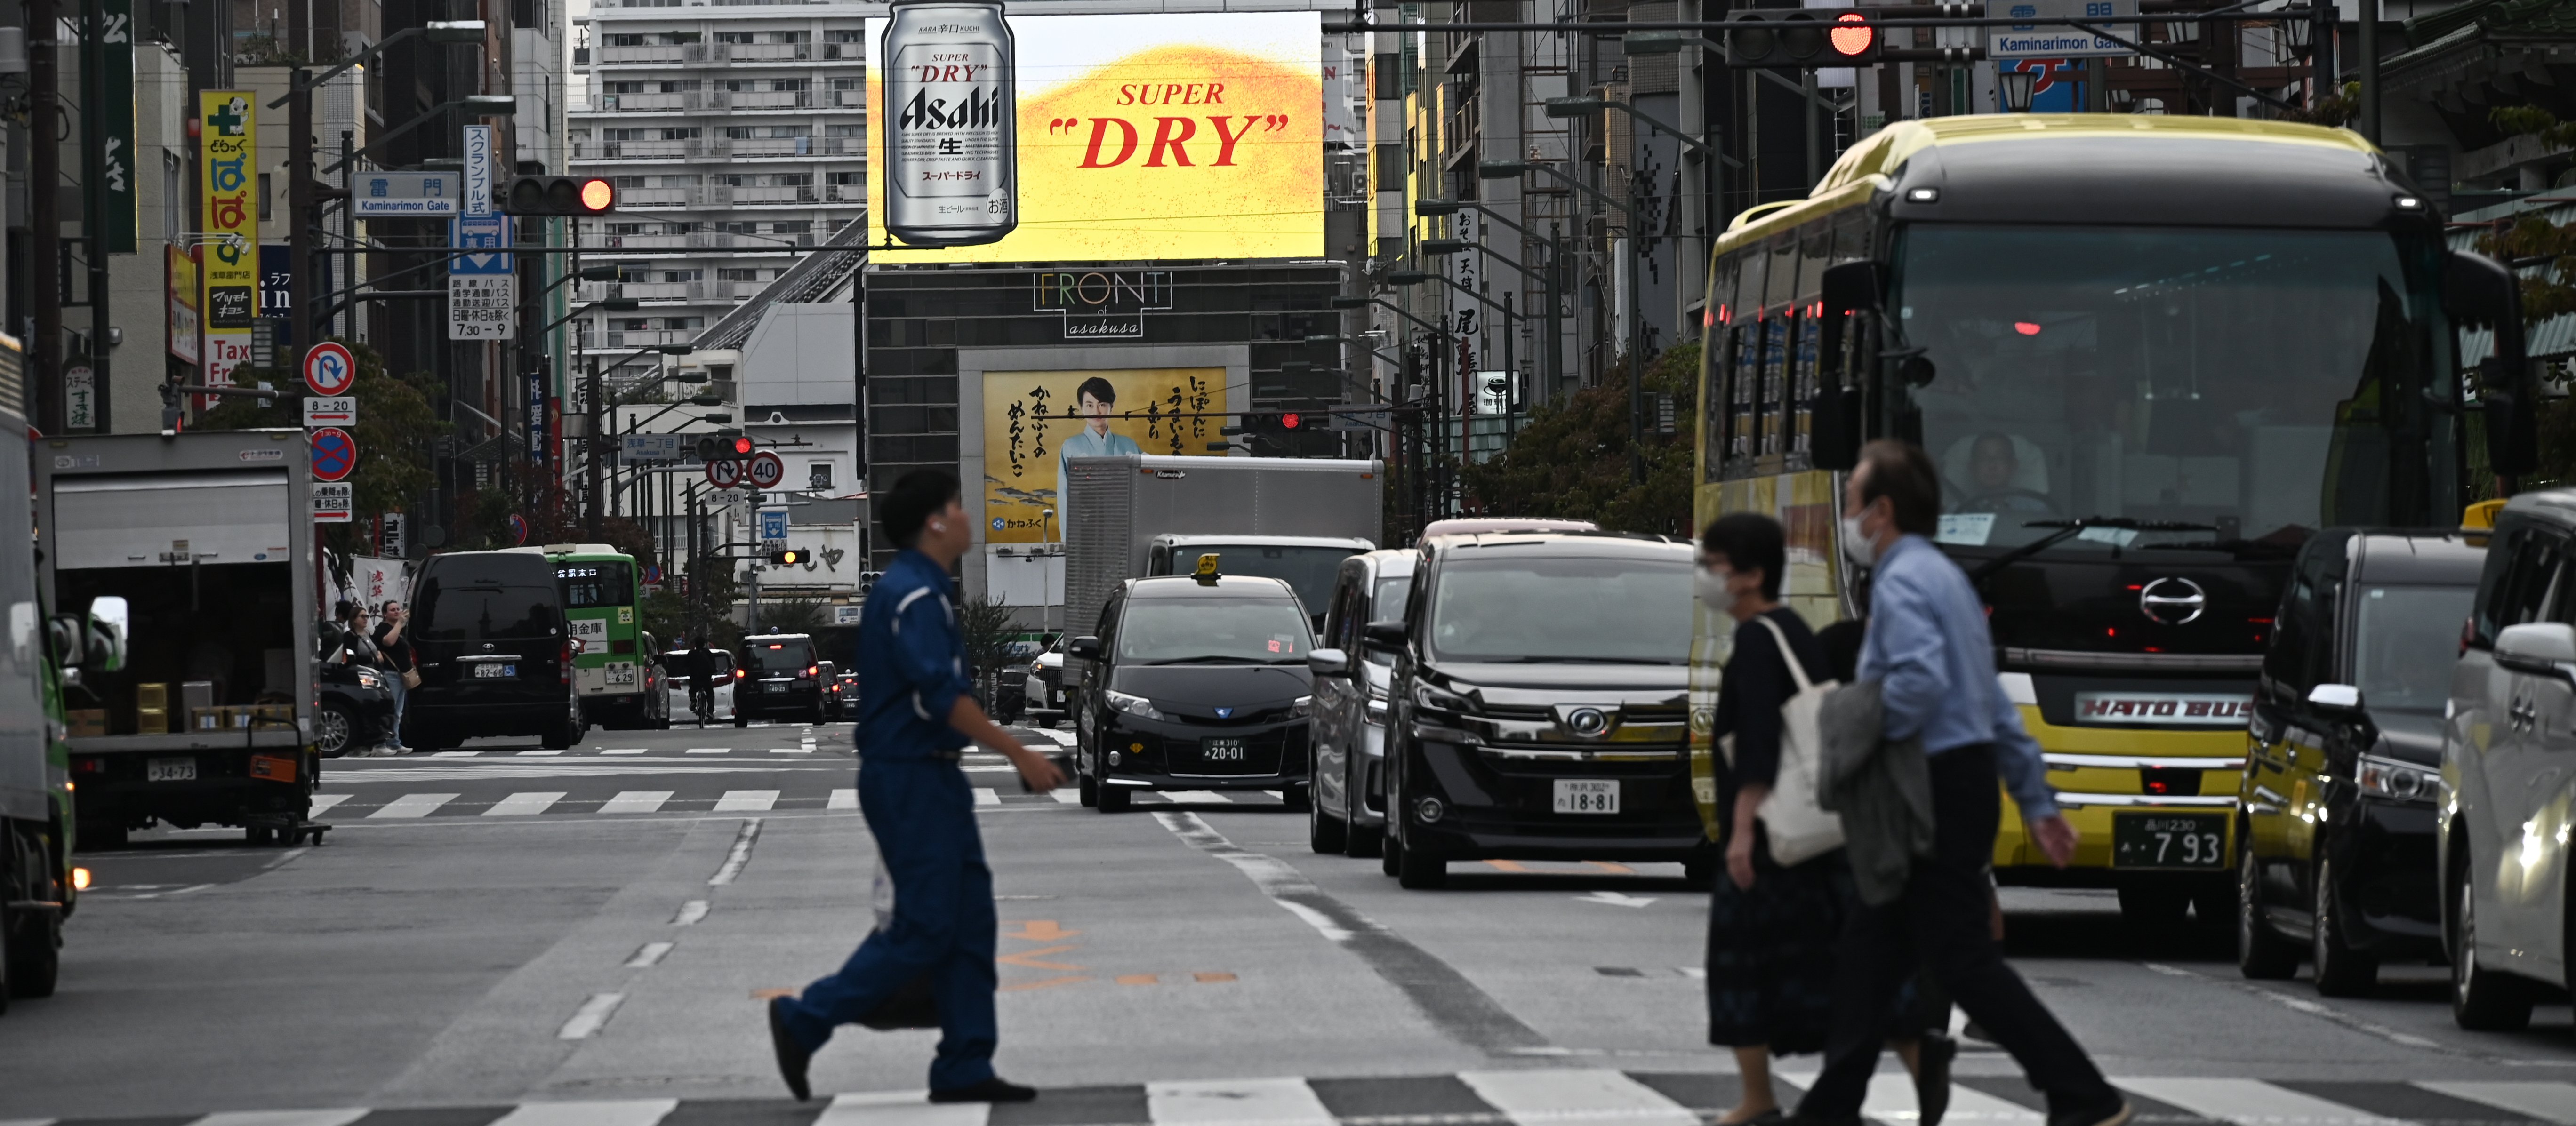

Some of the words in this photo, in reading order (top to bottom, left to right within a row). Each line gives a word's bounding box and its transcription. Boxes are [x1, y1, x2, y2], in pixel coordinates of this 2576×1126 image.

[938, 24, 959, 33] 辛口
[2000, 37, 2087, 51] Kaminarimon
[1116, 83, 1225, 105] SUPER
[899, 86, 999, 130] Asahi
[210, 139, 247, 152] どらっく
[939, 138, 963, 155] 生
[471, 129, 485, 214] スクランブル式
[923, 171, 981, 180] スーパードライ
[370, 179, 441, 197] 雷門
[362, 201, 423, 211] Kaminarimon
[427, 201, 450, 211] Gate
[939, 205, 964, 213] 生ビール
[988, 198, 1008, 214] お酒
[453, 279, 509, 288] 路線バス
[1041, 272, 1165, 305] FRONT
[213, 291, 248, 305] マツモト
[218, 304, 245, 318] キヨシ
[1098, 304, 1107, 317] of
[1069, 318, 1138, 334] asakusa
[214, 340, 249, 360] Tax
[627, 438, 674, 448] 浅草一丁目
[1008, 400, 1025, 477] めんたいこ
[754, 463, 775, 478] 40
[1007, 519, 1042, 529] かねふく
[552, 568, 597, 578] 袋駅東口
[2083, 700, 2178, 715] HATO
[2184, 701, 2252, 716] BUS
[1212, 746, 1243, 760] 20-01
[1571, 793, 1613, 810] 18-81
